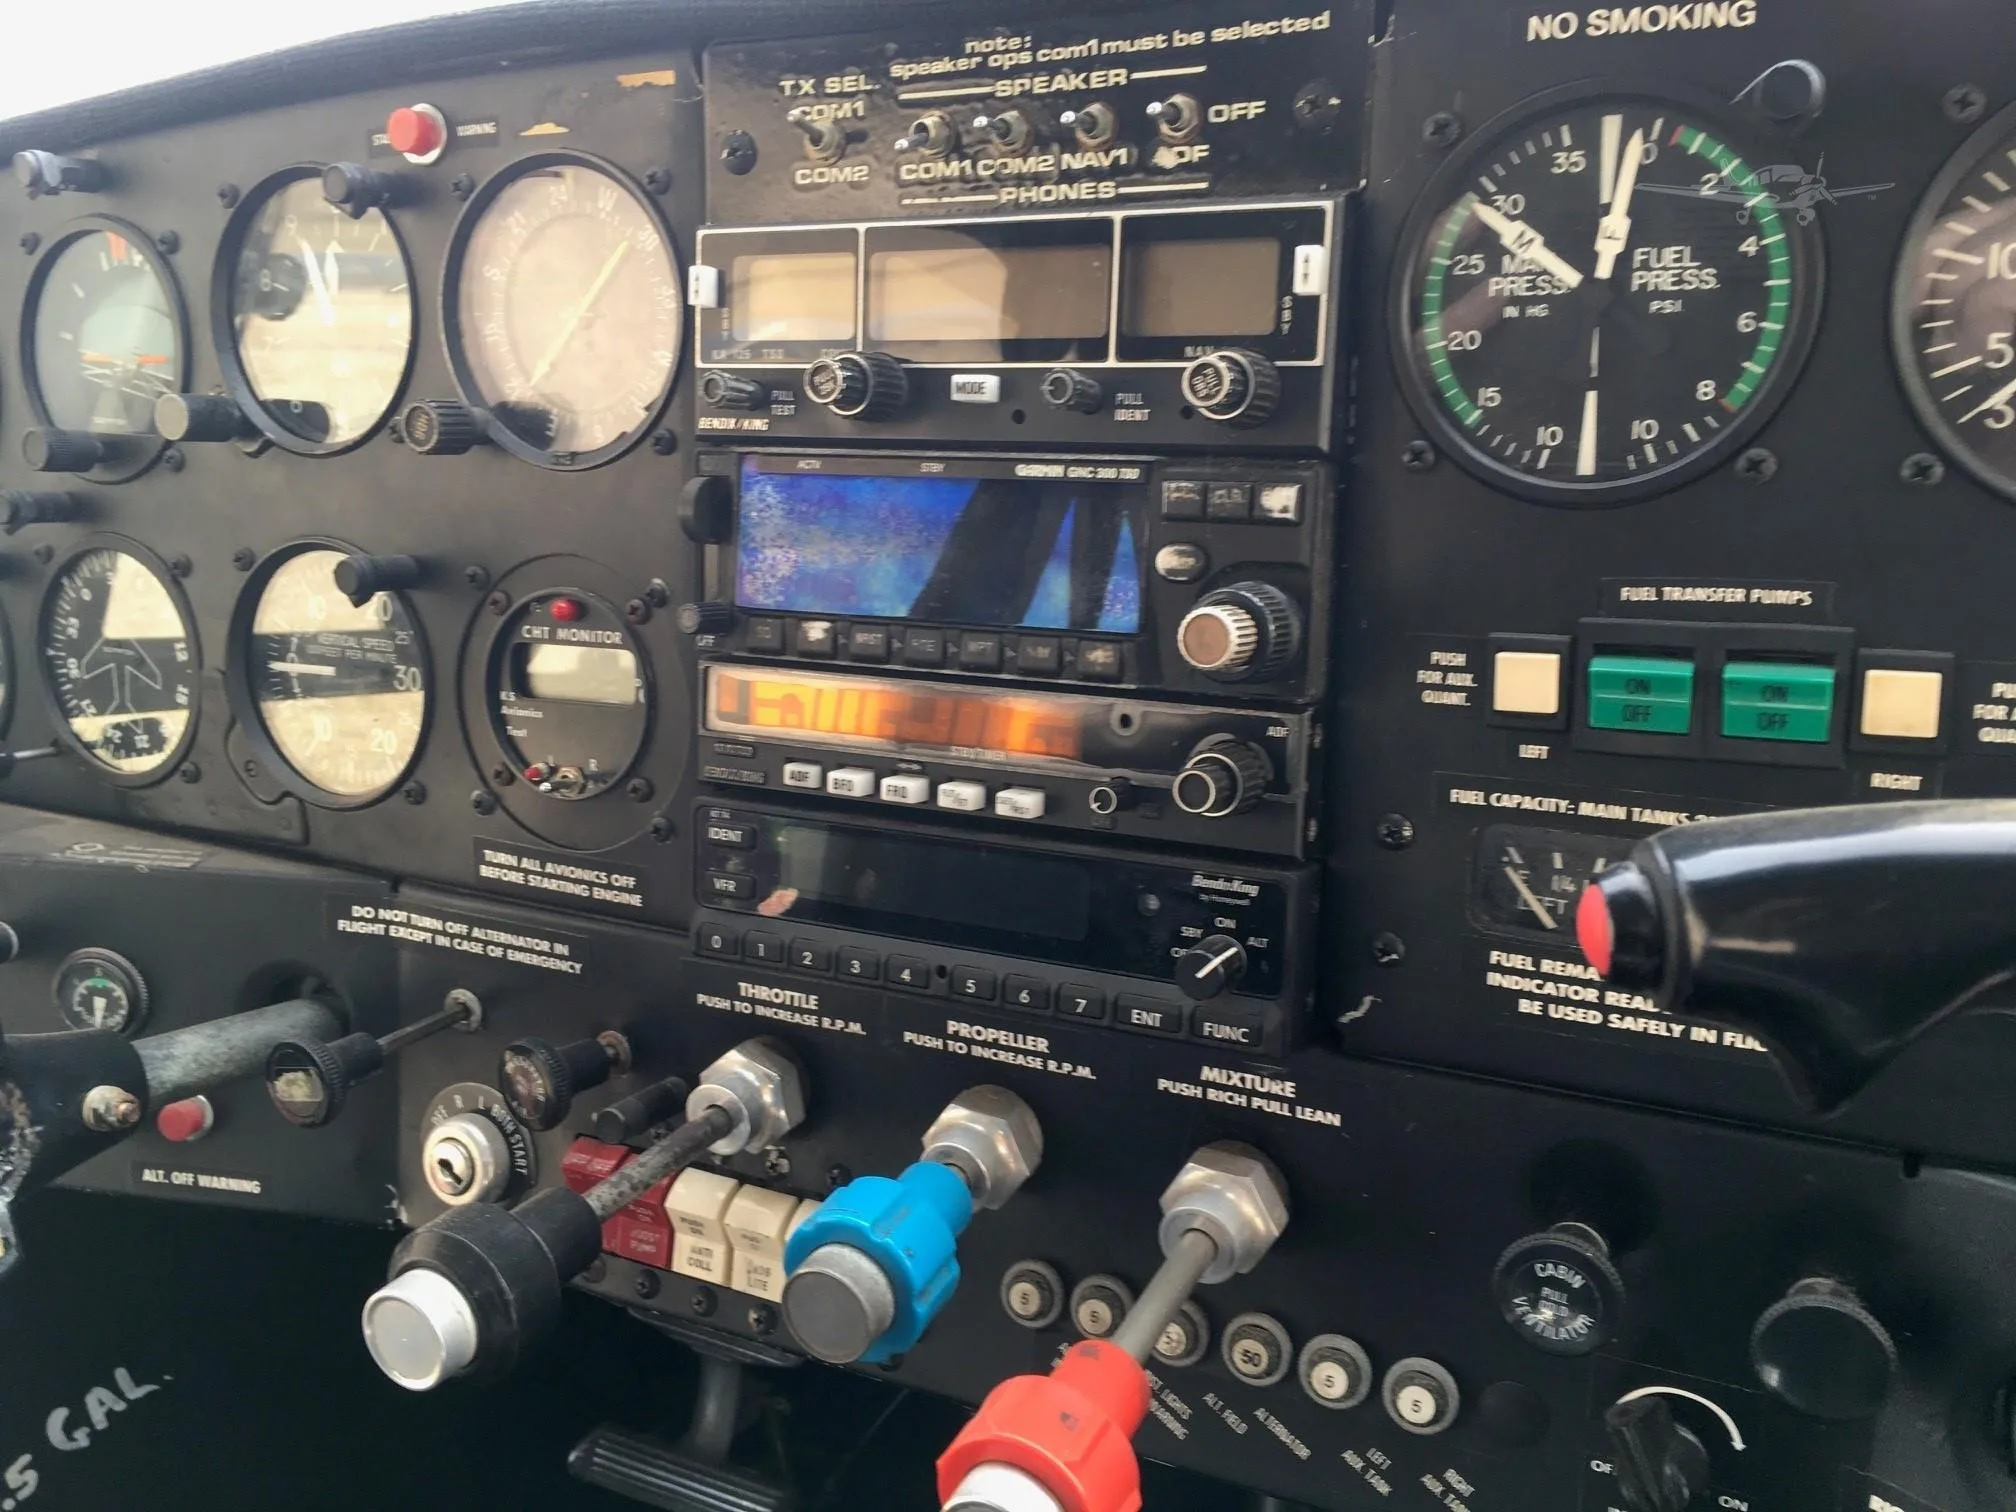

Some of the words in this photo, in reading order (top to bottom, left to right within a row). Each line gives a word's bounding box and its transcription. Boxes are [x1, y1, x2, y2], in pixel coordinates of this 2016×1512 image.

[1526, 11, 1578, 42] NO
[1585, 0, 1759, 37] SMOKING
[890, 56, 982, 80] speaker
[988, 52, 1032, 71] ops
[1101, 33, 1169, 54] must
[1172, 30, 1205, 48] be
[1211, 10, 1331, 42] selected
[965, 35, 1032, 54] note:
[779, 79, 816, 96] TX
[994, 68, 1128, 97] SPEAKER
[797, 100, 865, 121] COM1
[1207, 100, 1267, 123] OFF
[900, 159, 972, 180] COM1
[976, 155, 1055, 176] COM2
[1061, 148, 1129, 170] NAV1
[1152, 144, 1210, 168] DF
[1550, 150, 1588, 173] 35
[1641, 142, 1658, 165] 0
[794, 165, 870, 185] COM2
[1700, 173, 1719, 195] 2
[1001, 181, 1117, 204] PHONES
[1490, 193, 1526, 215] 30
[1738, 235, 1758, 257] 4
[1451, 254, 1485, 275] 25
[1632, 245, 1701, 269] FUEL
[1630, 268, 1721, 292] PRESS.
[1502, 305, 1519, 318] IN
[1737, 312, 1756, 333] 6
[1447, 330, 1482, 350] 20
[956, 381, 987, 395] MODE
[1478, 387, 1502, 408] 15
[1695, 379, 1716, 401] 8
[1114, 393, 1144, 405] PULL
[1113, 409, 1151, 421] IDENT
[1537, 426, 1564, 447] 10
[1631, 419, 1660, 440] 10
[1620, 586, 1659, 601] FUEL
[1661, 586, 1746, 603] TRANSFER
[1750, 588, 1813, 606] PUMPS
[521, 625, 549, 639] CHT
[556, 629, 624, 644] MONITOR
[1430, 651, 1467, 666] PUSH
[393, 664, 422, 691] 30
[1416, 670, 1444, 684] FOR
[1625, 678, 1649, 695] ON
[1761, 685, 1790, 702] ON
[1621, 704, 1652, 722] OFF
[1757, 713, 1791, 731] OFF
[1972, 704, 2010, 720] FOR
[1518, 744, 1550, 759] LEFT
[789, 770, 810, 782] ADF
[1870, 772, 1923, 791] RIGHT
[1450, 788, 1487, 806] FUEL
[1489, 793, 1575, 815] CAPACITY:
[1577, 802, 1627, 820] MAIN
[1631, 807, 1691, 827] TANKS
[708, 827, 743, 842] IDENT
[482, 849, 518, 866] TURN
[520, 855, 542, 873] ALL
[544, 862, 608, 886] AVIONICS
[611, 873, 637, 889] OFF
[479, 864, 525, 885] BEFORE
[527, 873, 590, 897] STARTING
[593, 886, 643, 907] ENGINE
[712, 877, 737, 892] VFR
[351, 905, 375, 919] DO
[378, 908, 409, 923] NOT
[410, 913, 443, 931] TURN
[444, 921, 469, 937] OFF
[471, 926, 553, 953] ALTERNATOR
[553, 943, 569, 956] IN
[1214, 917, 1236, 929] ON
[337, 919, 387, 937] FLIGHT
[389, 925, 432, 944] EXCEPT
[435, 933, 451, 948] IN
[453, 938, 485, 955] CASE
[486, 944, 505, 958] OF
[506, 948, 583, 974] EMERGENCY
[711, 935, 722, 948] 0
[757, 943, 765, 957] 1
[1246, 936, 1269, 948] ALT
[802, 951, 813, 965] 2
[850, 960, 861, 973] 3
[1489, 950, 1536, 972] FUEL
[900, 968, 912, 982] 4
[738, 981, 819, 1010] THROTTLE
[965, 979, 977, 993] 5
[1018, 989, 1030, 1003] 6
[1486, 972, 1600, 1003] INDICATOR
[697, 993, 731, 1011] PUSH
[734, 1001, 753, 1013] TO
[755, 1004, 819, 1027] INCREASE
[821, 1016, 867, 1035] R.P.M.
[1075, 999, 1087, 1013] 7
[1131, 1009, 1163, 1028] ENT
[1518, 999, 1543, 1015] BE
[1548, 1003, 1603, 1025] USED
[1607, 1013, 1686, 1038] SAFELY
[1690, 1026, 1717, 1043] IN
[947, 1020, 1049, 1053] PROPELLER
[1203, 1022, 1249, 1043] FUNC
[903, 1031, 943, 1051] PUSH
[946, 1039, 968, 1054] TO
[971, 1044, 1044, 1070] INCREASE
[1047, 1059, 1097, 1080] R.P.M.
[1200, 1065, 1297, 1098] MIXTURE
[1157, 1078, 1203, 1098] PUSH
[1206, 1088, 1248, 1107] RICH
[1250, 1097, 1293, 1117] PULL
[1295, 1106, 1341, 1127] LEAN
[509, 1134, 528, 1176] START
[171, 1172, 195, 1187] OFF
[197, 1175, 262, 1194] WARNING
[1533, 1263, 1586, 1289] CABIN
[1240, 1350, 1262, 1367] 50
[1323, 1374, 1336, 1389] 5
[1411, 1400, 1423, 1414] 5
[1221, 1409, 1249, 1435] FIELD
[1253, 1407, 1312, 1461] ALTERNATOR
[1366, 1447, 1392, 1470] LEFT
[1443, 1468, 1475, 1497] RIGHT
[1718, 1495, 1748, 1512] ON
